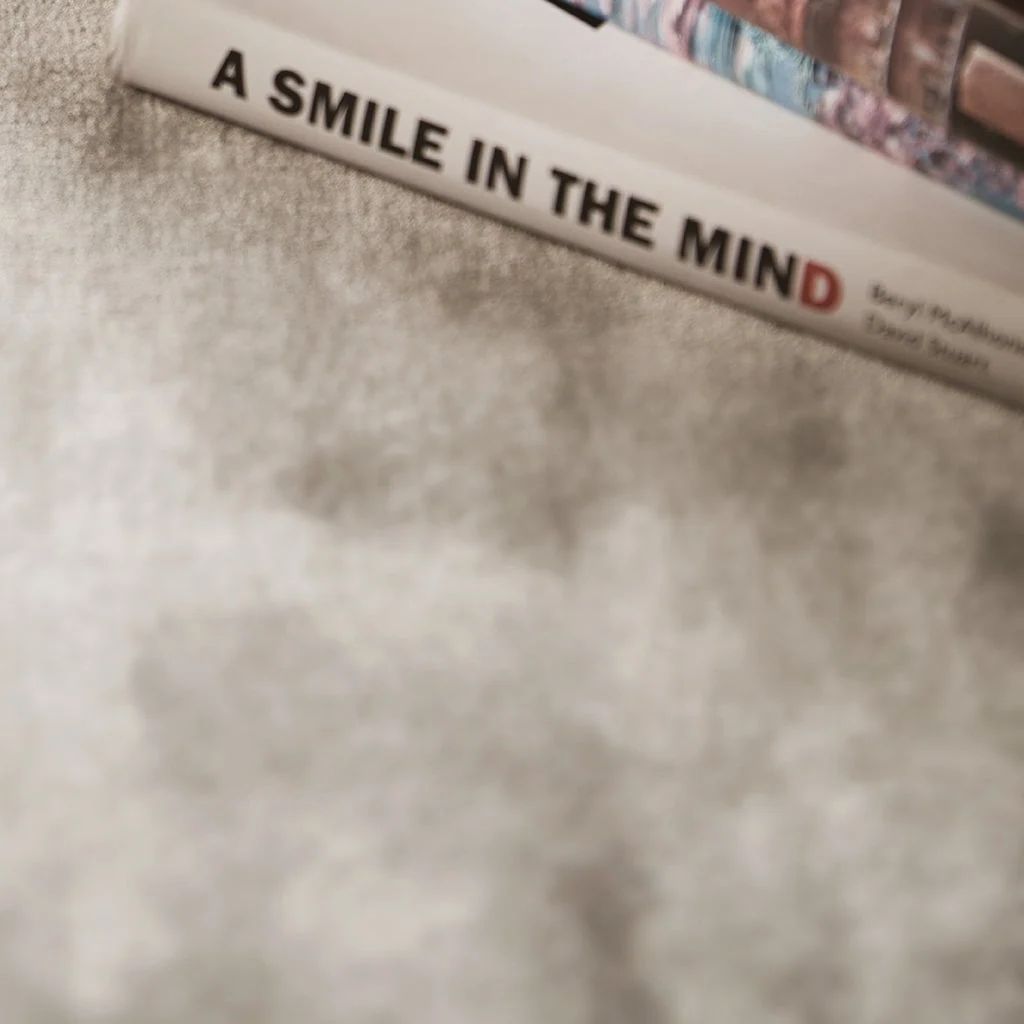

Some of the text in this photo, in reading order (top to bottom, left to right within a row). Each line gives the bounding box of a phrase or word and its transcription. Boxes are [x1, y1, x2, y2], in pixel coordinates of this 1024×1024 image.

[211, 47, 845, 316] A SMILE IN THE MIND
